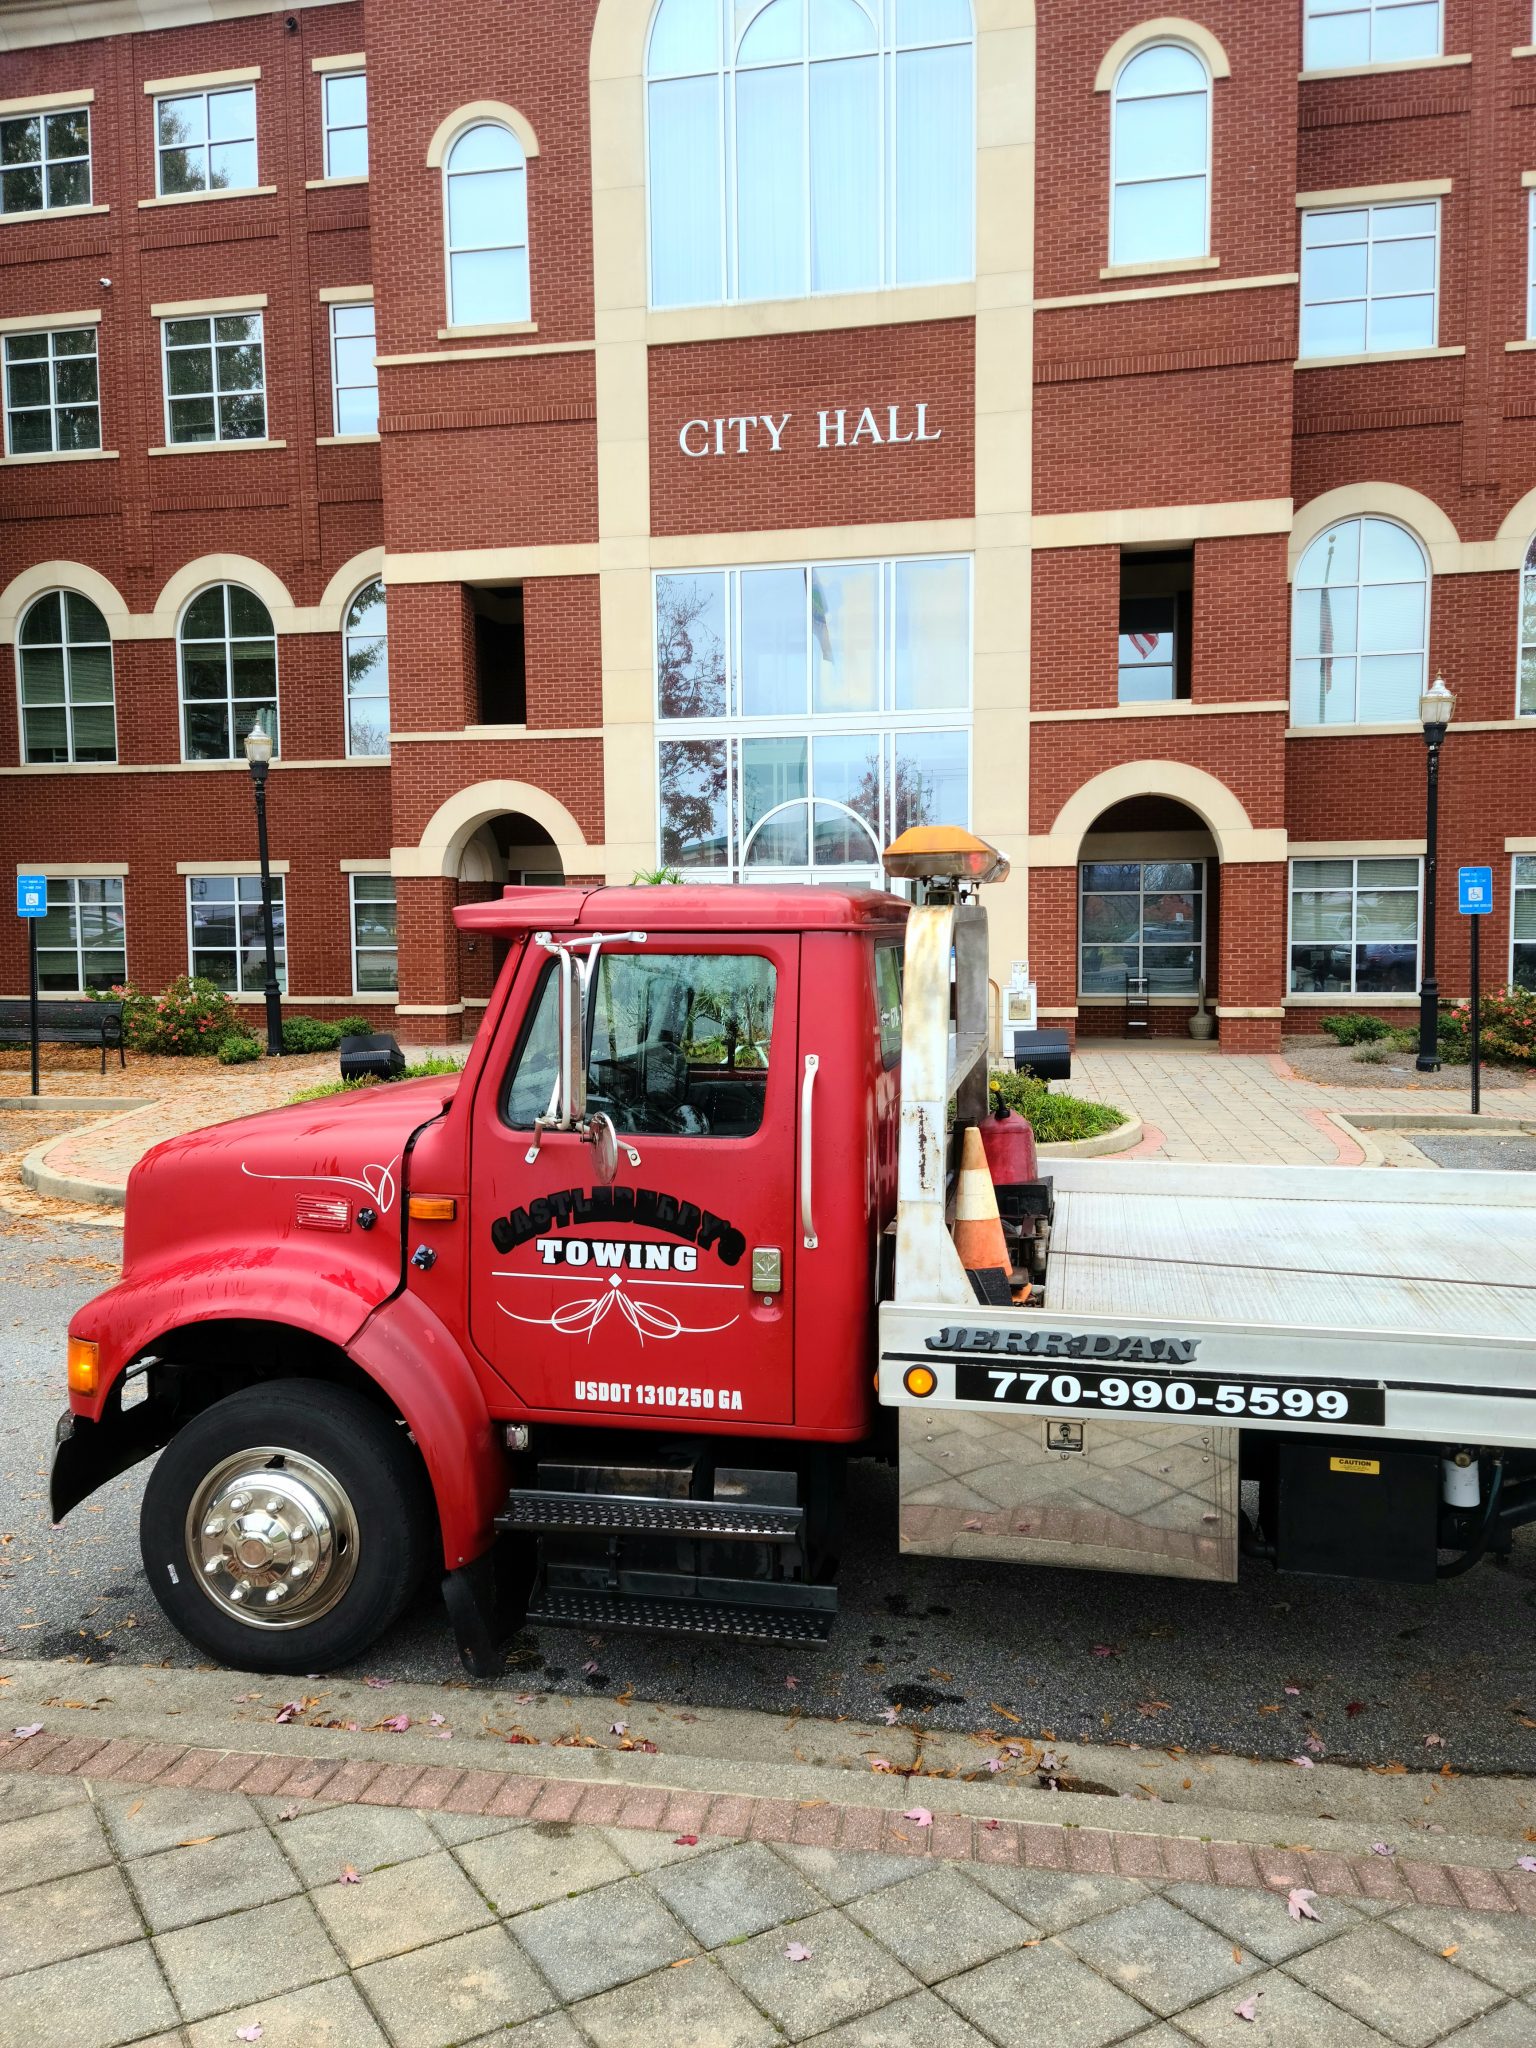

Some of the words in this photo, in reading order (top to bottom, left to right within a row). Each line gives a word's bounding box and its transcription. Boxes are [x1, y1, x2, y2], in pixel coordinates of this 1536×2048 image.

[679, 413, 792, 457] CITY
[817, 403, 942, 448] HALL
[536, 1238, 698, 1271] TOWING
[575, 1380, 632, 1403] USDOT
[636, 1385, 714, 1409] 1310250
[718, 1389, 743, 1410] GA
[988, 1370, 1349, 1420] 770-990-5599
[1338, 1459, 1372, 1467] CAUTION
